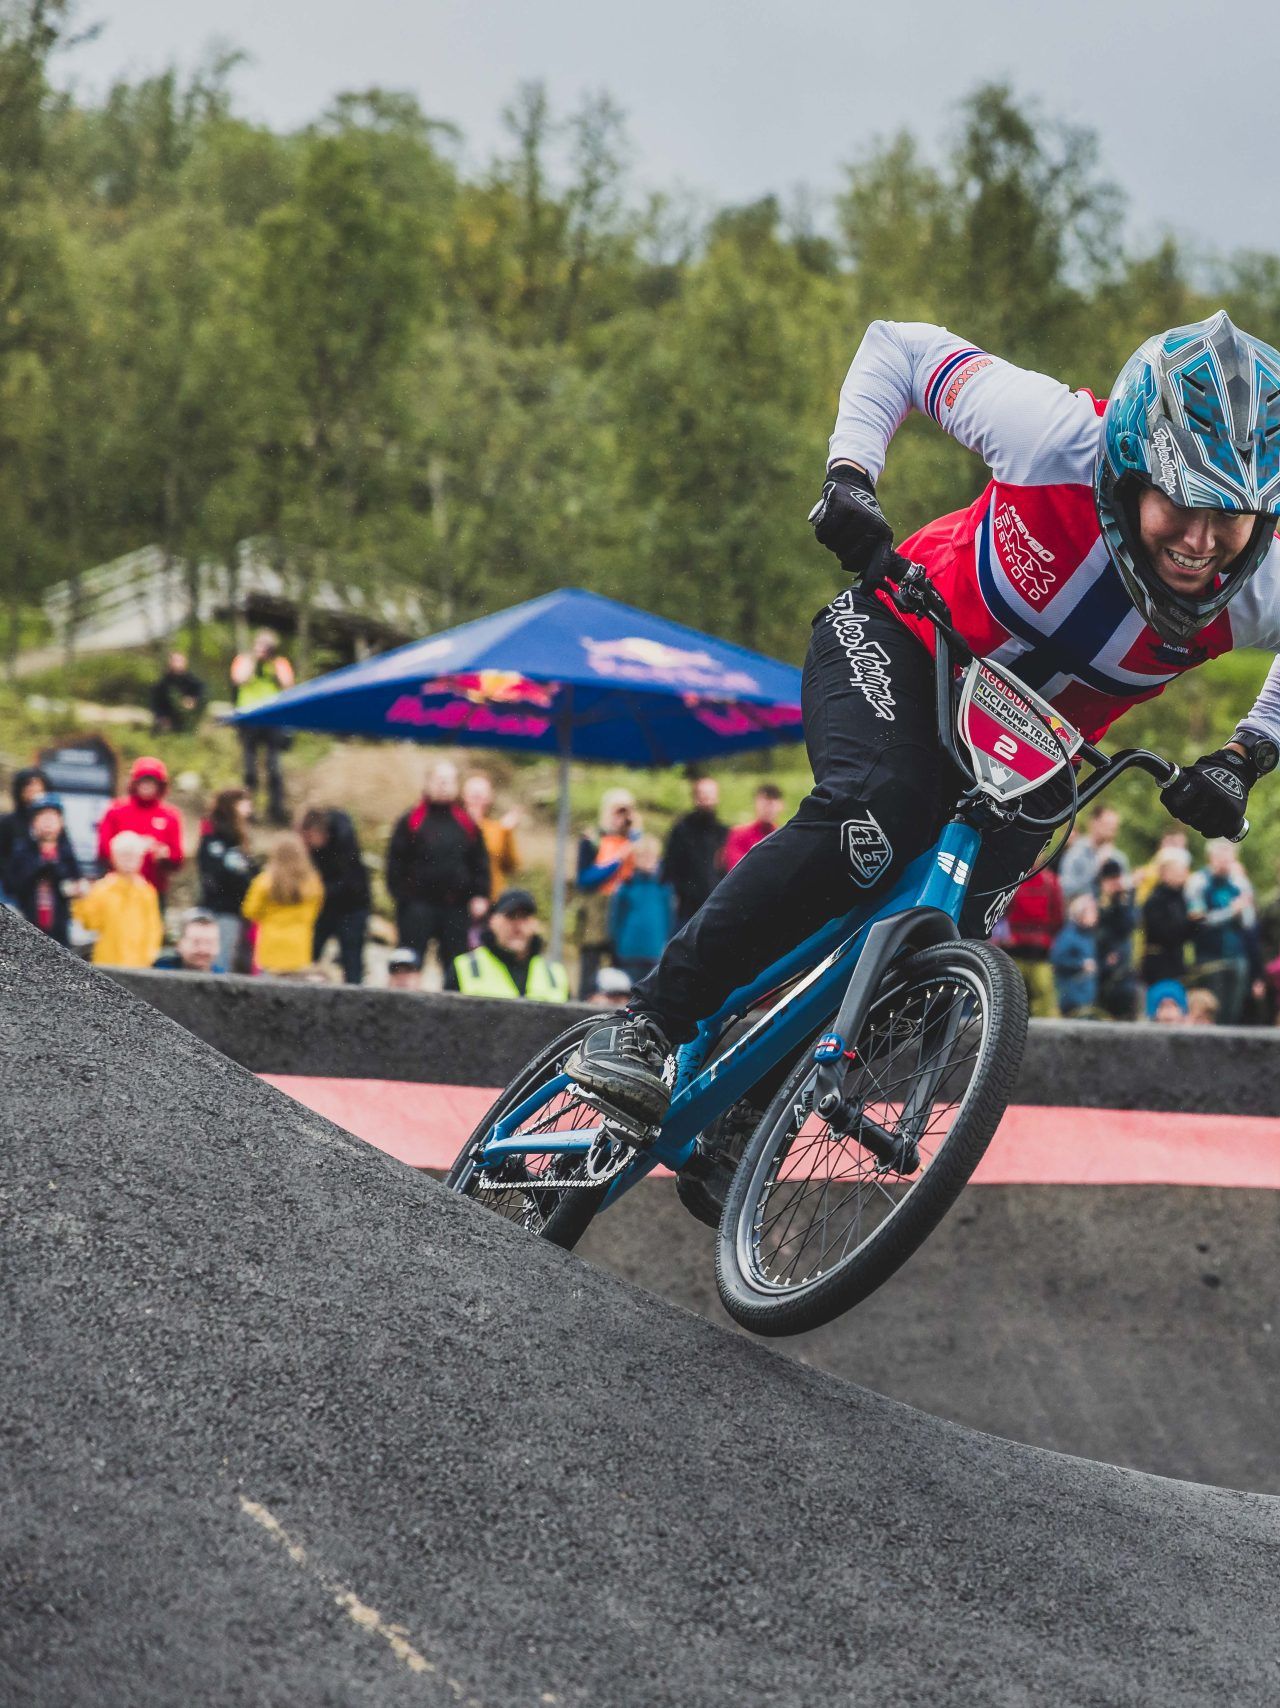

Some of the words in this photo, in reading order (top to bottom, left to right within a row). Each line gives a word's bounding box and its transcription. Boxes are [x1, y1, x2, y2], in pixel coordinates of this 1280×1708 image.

[945, 357, 993, 410] MAXXIS
[994, 516, 1041, 601] ØSTFOLD
[1009, 505, 1056, 563] MEYBO
[831, 613, 871, 648] Lee
[981, 686, 1001, 708] UCI
[999, 702, 1030, 729] PUMP
[1028, 723, 1062, 754] TRACK
[993, 734, 1018, 761] 2
